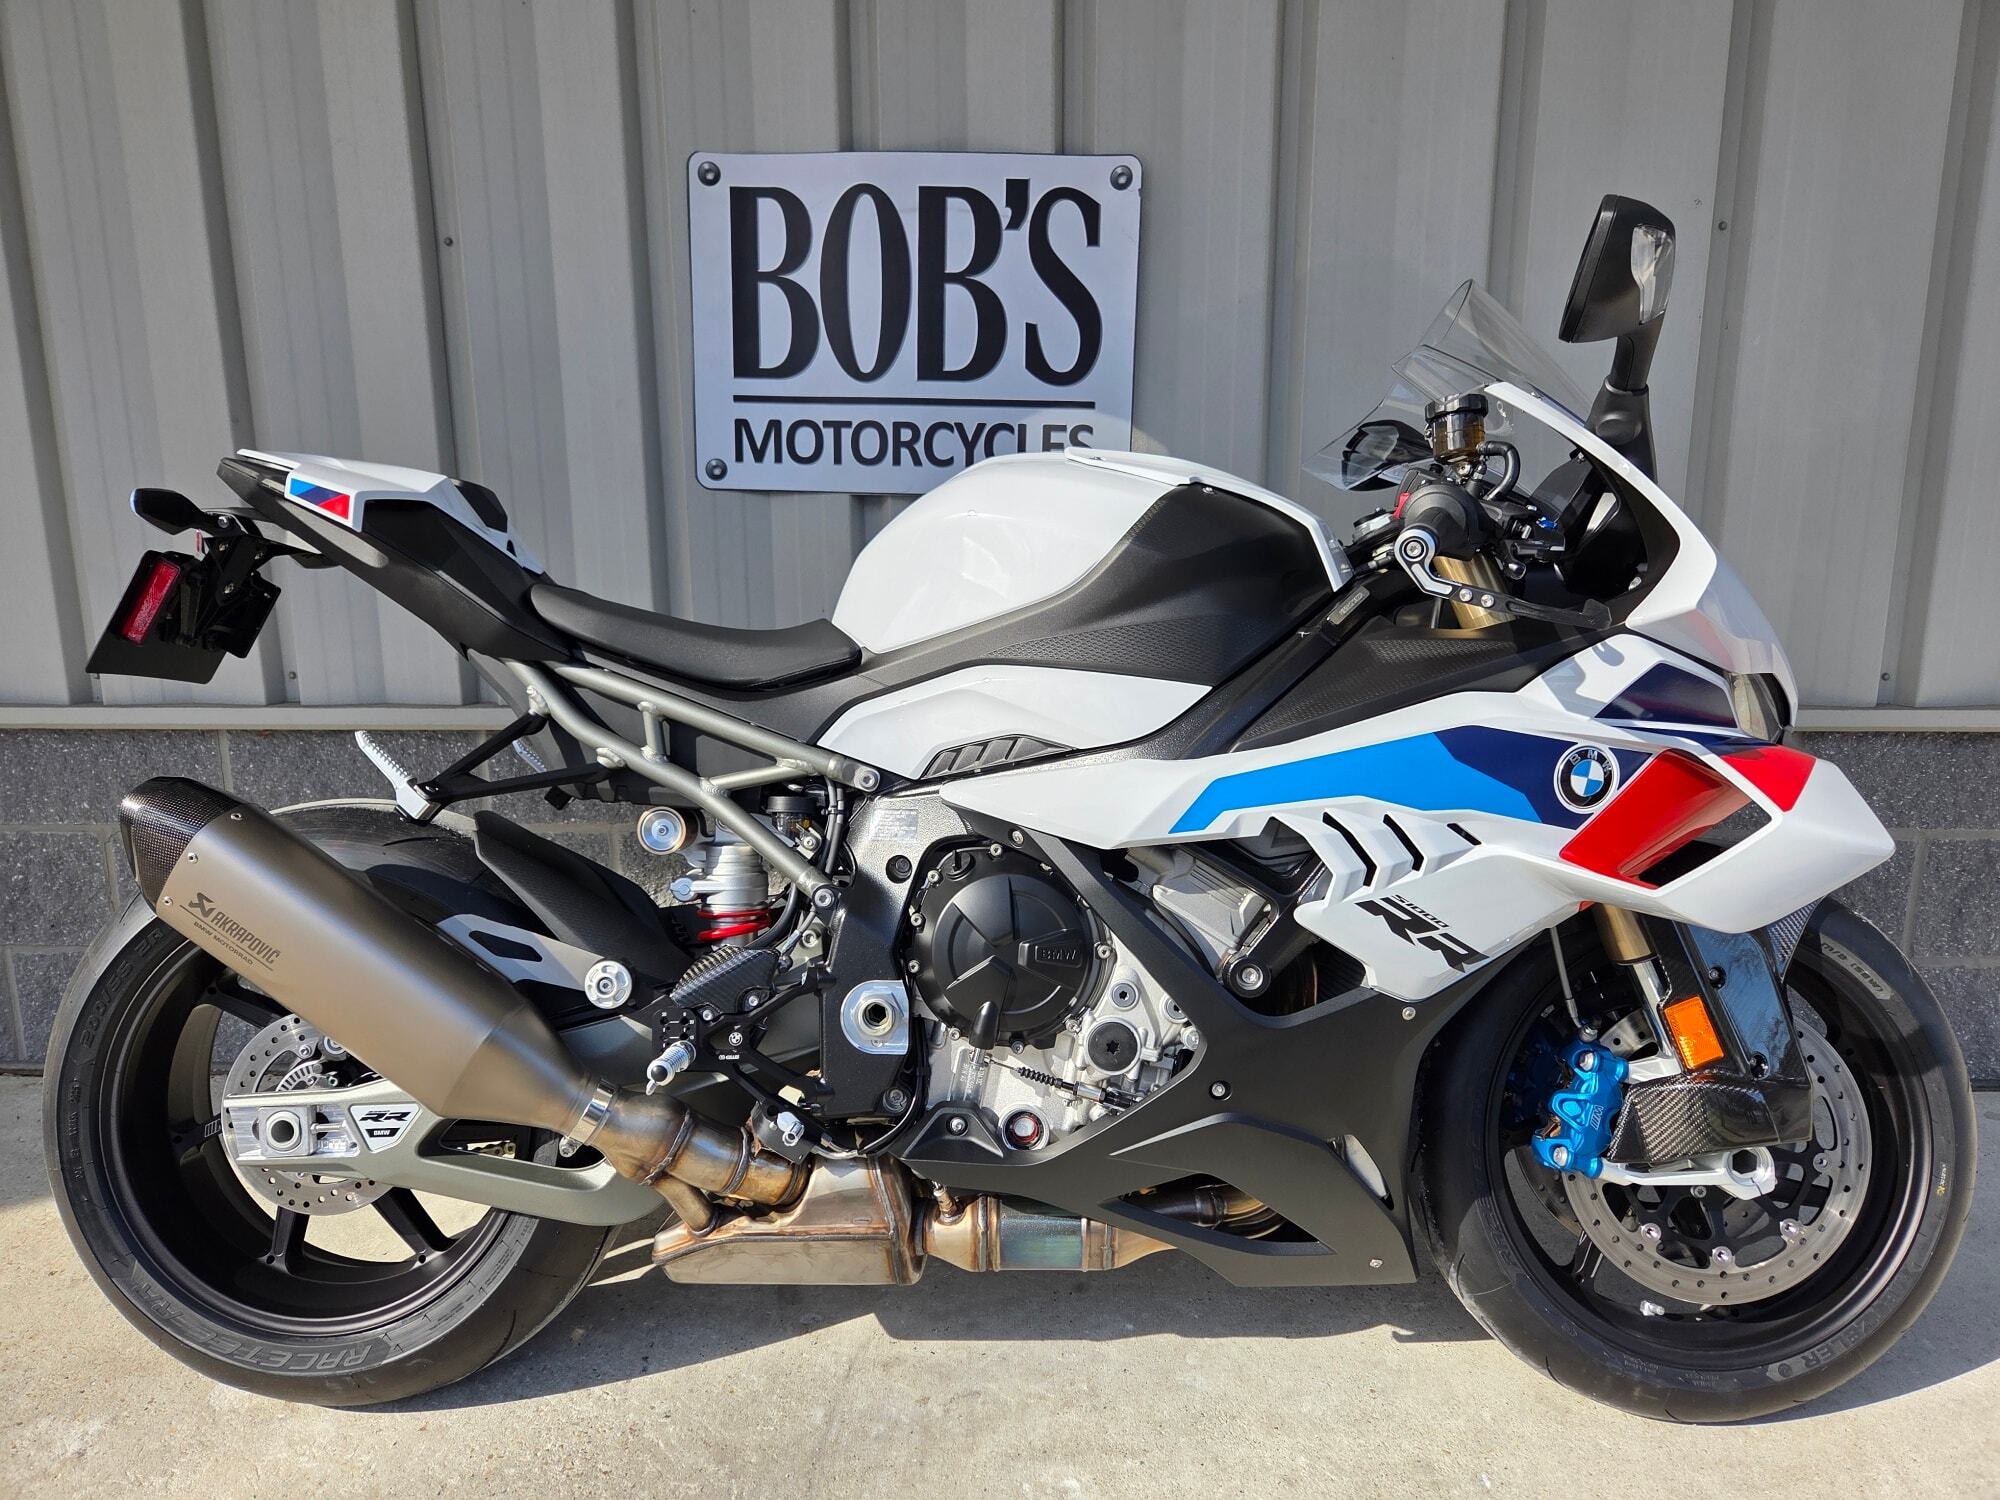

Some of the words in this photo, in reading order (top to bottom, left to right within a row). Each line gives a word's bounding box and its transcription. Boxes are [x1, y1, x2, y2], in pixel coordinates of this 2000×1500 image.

[729, 178, 1103, 386] BOB'S
[1391, 894, 1450, 928] S1000
[193, 921, 213, 936] BMW
[214, 935, 254, 965] MOTORRAD
[1353, 896, 1491, 973] RR
[1041, 949, 1077, 960] BMW
[359, 1111, 412, 1123] RR
